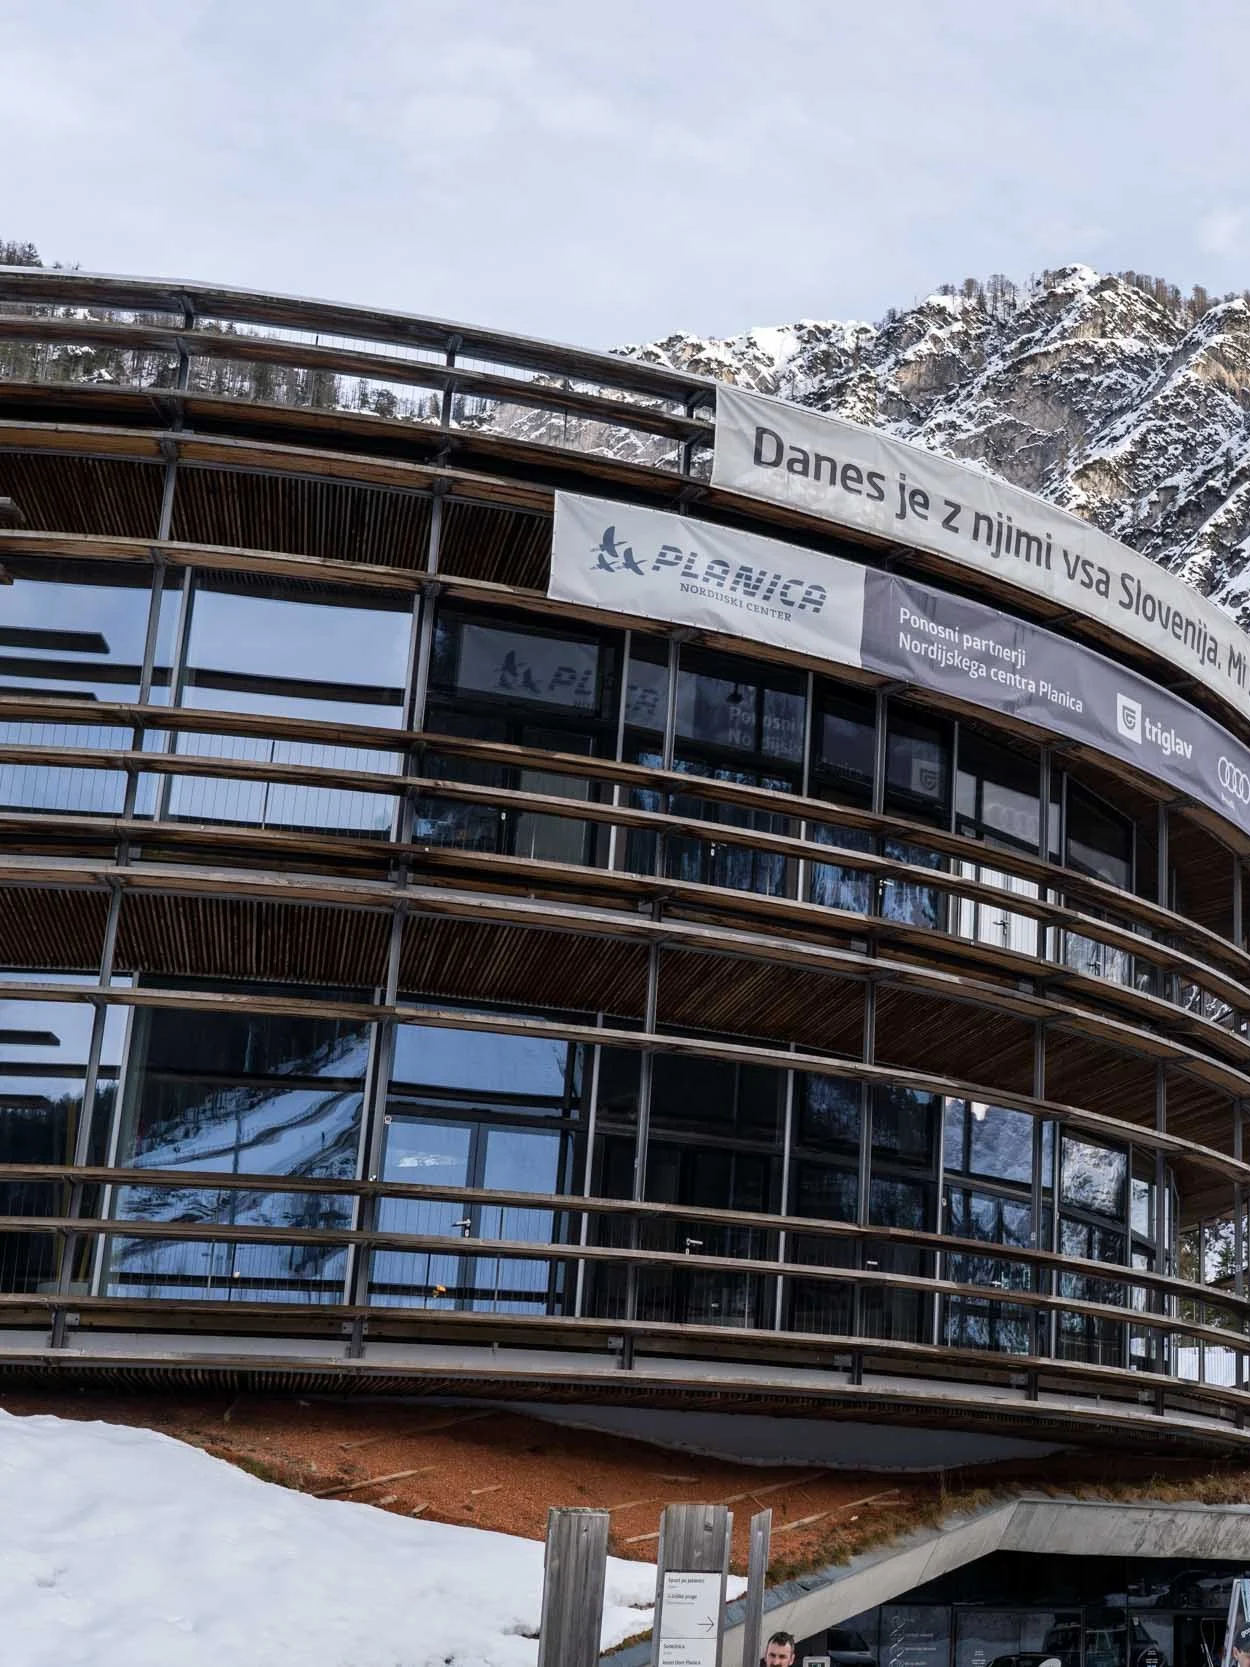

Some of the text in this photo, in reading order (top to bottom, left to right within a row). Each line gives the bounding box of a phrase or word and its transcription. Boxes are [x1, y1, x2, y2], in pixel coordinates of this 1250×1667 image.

[652, 544, 827, 614] PLANICA
[753, 426, 885, 502] Danes
[895, 472, 930, 521] je
[941, 499, 962, 534] z
[972, 511, 1052, 570] njimi
[1063, 549, 1110, 600] vsa
[1118, 572, 1221, 669] Slovenija.
[1228, 644, 1246, 689] Mi
[679, 582, 792, 623] NORDIJSKI CENTER
[899, 607, 1026, 669] Ponosni partnerji
[899, 631, 1084, 714] Nordijskega centra Planica
[1144, 717, 1193, 760] triglav
